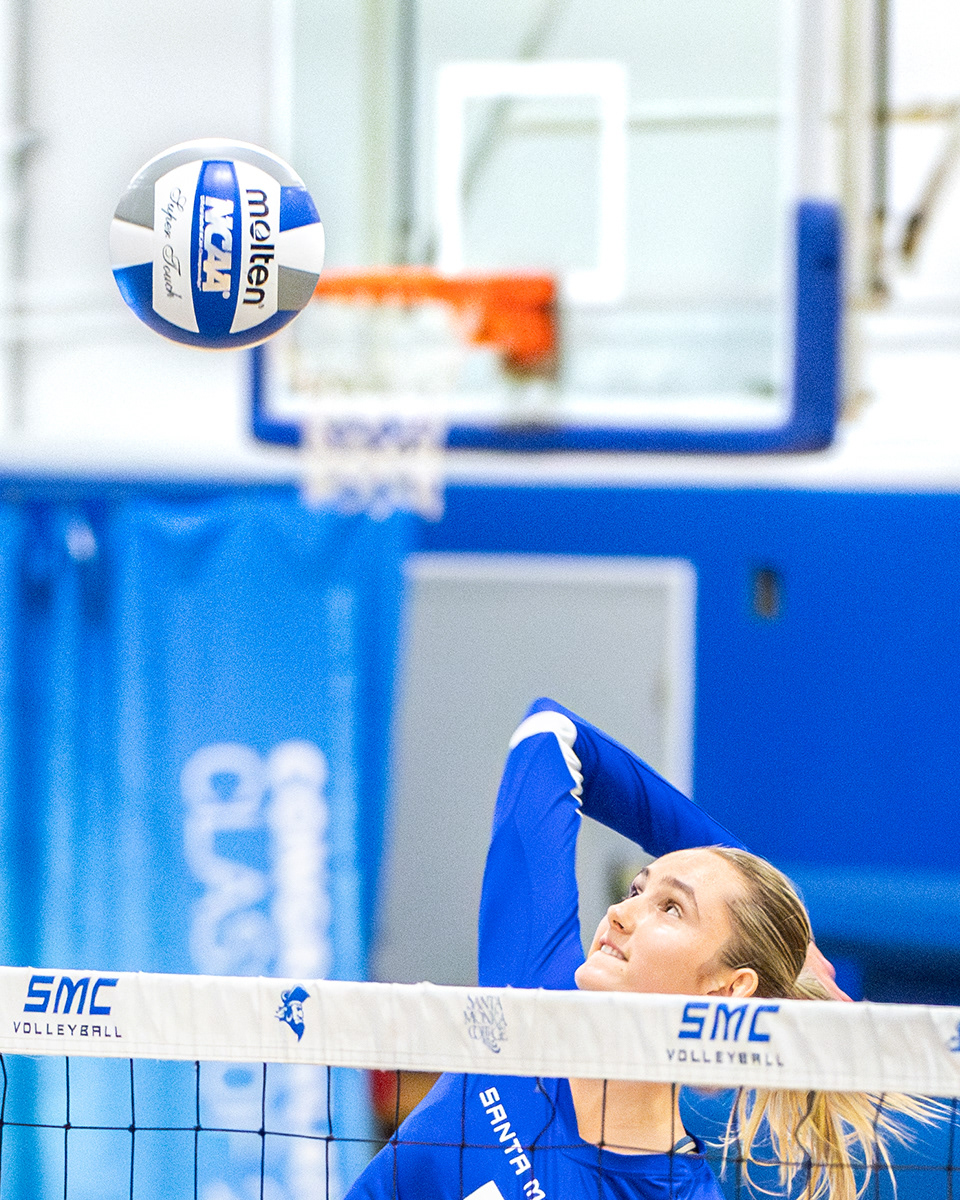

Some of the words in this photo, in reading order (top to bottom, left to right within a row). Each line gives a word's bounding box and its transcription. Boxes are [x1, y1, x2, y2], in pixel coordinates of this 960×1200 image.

[161, 187, 187, 240] Super
[202, 195, 234, 293] NCAA
[243, 188, 275, 306] molten
[162, 244, 184, 300] Touch
[23, 975, 120, 1016] SMC
[12, 1021, 123, 1039] VOLLEYBALL
[677, 1002, 780, 1043] SMC
[666, 1047, 785, 1067] VOLLEYBALL
[479, 1086, 532, 1176] SANTA
